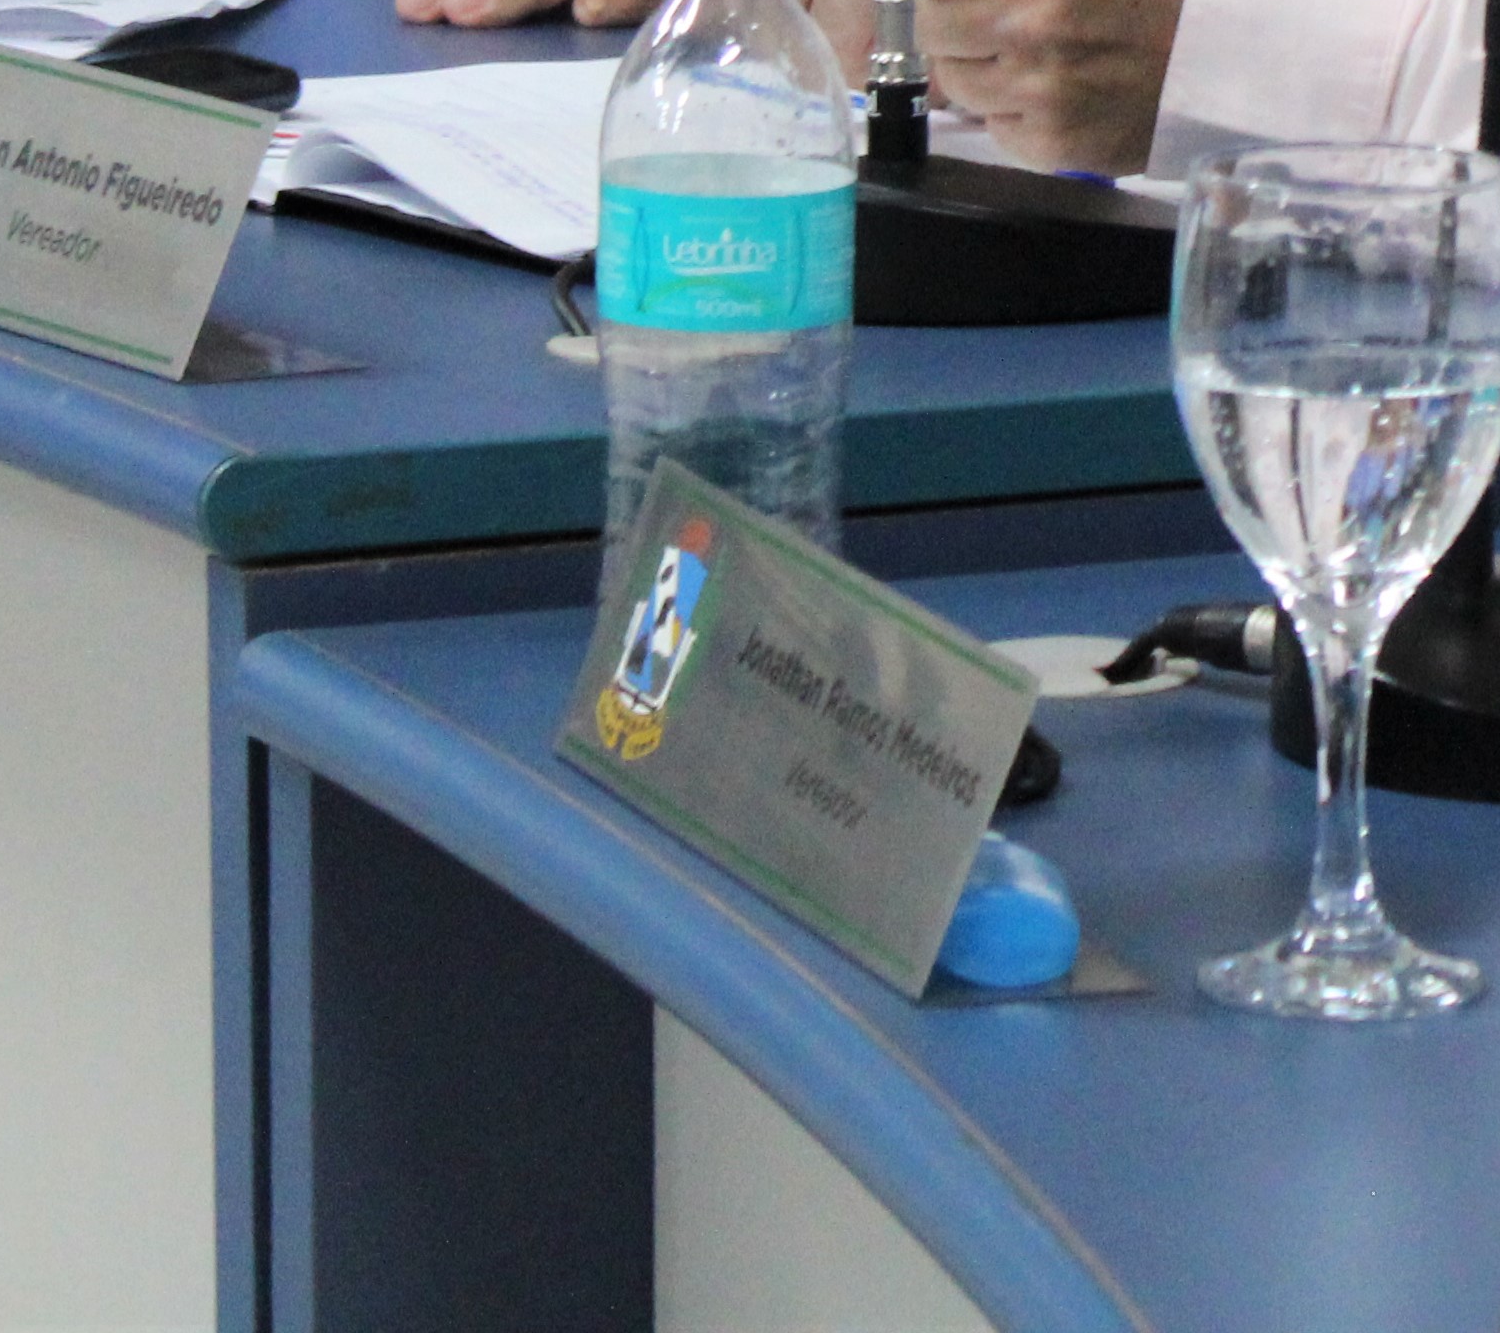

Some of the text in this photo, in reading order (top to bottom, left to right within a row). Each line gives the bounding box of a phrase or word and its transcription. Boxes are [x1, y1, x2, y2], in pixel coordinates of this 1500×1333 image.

[12, 137, 101, 193] Antonio
[102, 161, 225, 227] Figueiredo
[5, 209, 104, 263] Vereador
